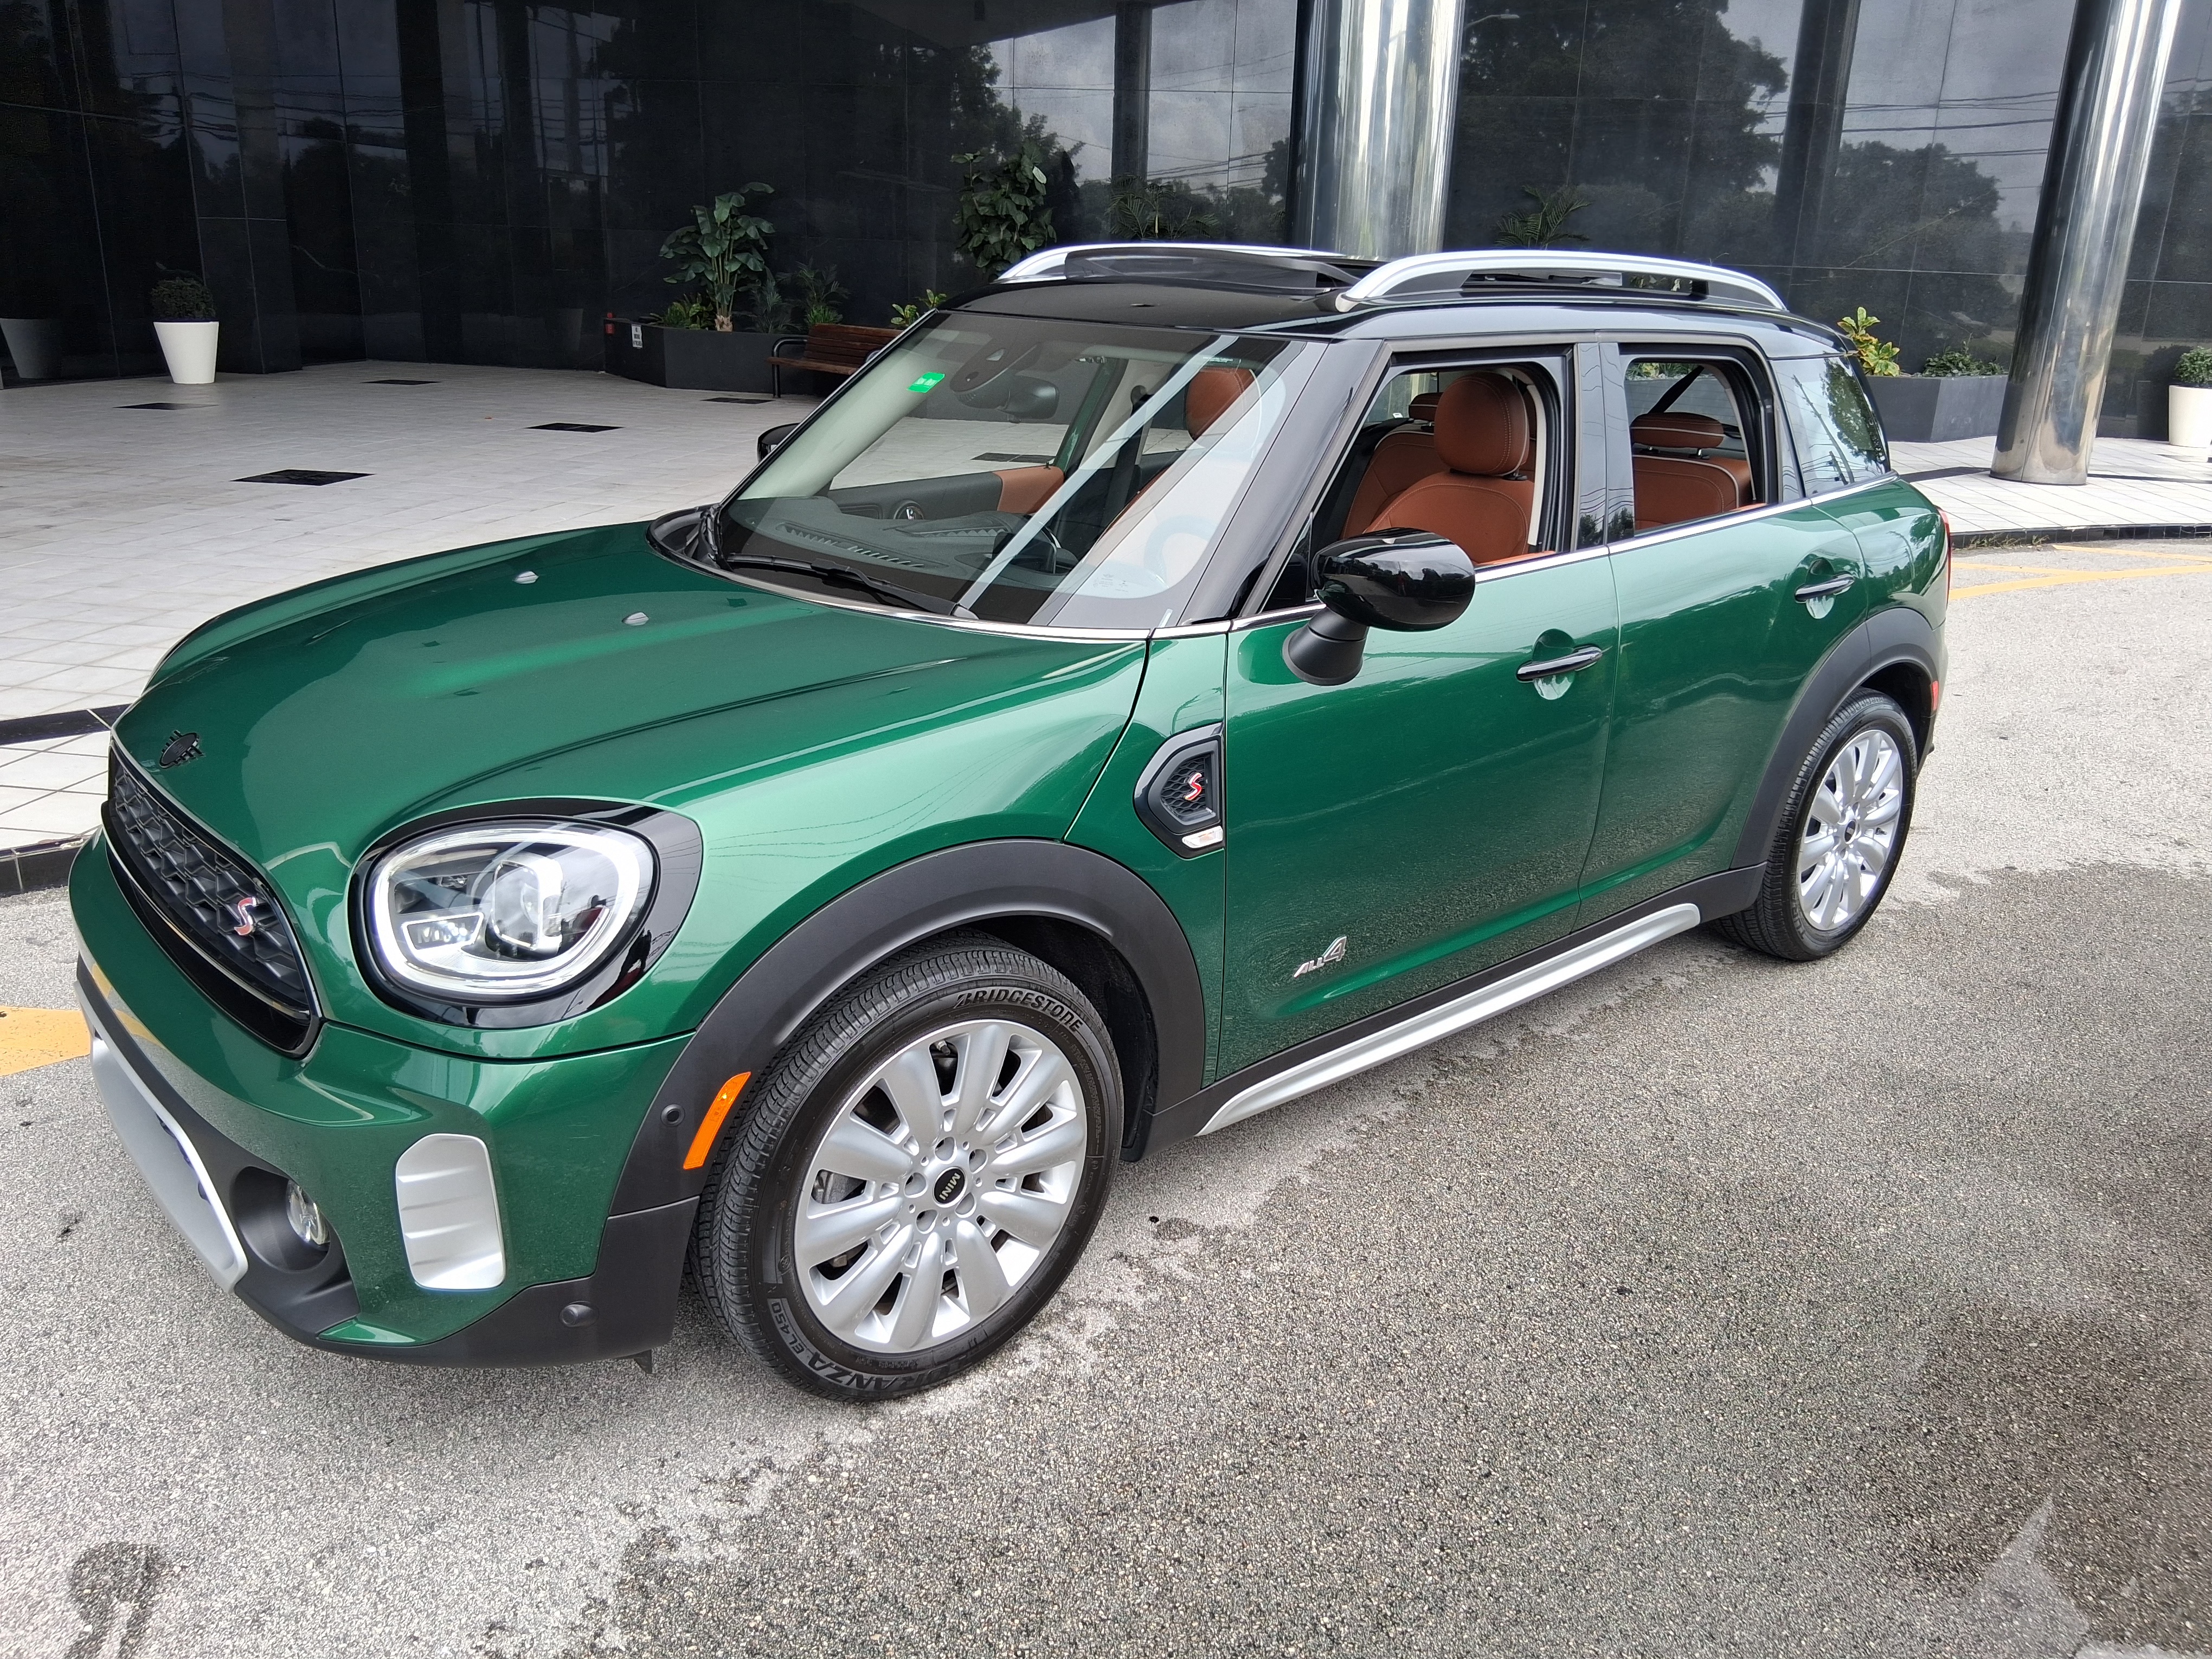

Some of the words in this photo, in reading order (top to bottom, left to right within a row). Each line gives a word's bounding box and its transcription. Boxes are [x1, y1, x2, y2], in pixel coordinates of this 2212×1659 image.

[1184, 772, 1203, 802] S
[234, 896, 256, 936] S
[953, 988, 1083, 1032] BRIDGESTONE
[939, 1172, 961, 1200] MINI
[771, 1302, 805, 1354] EL450
